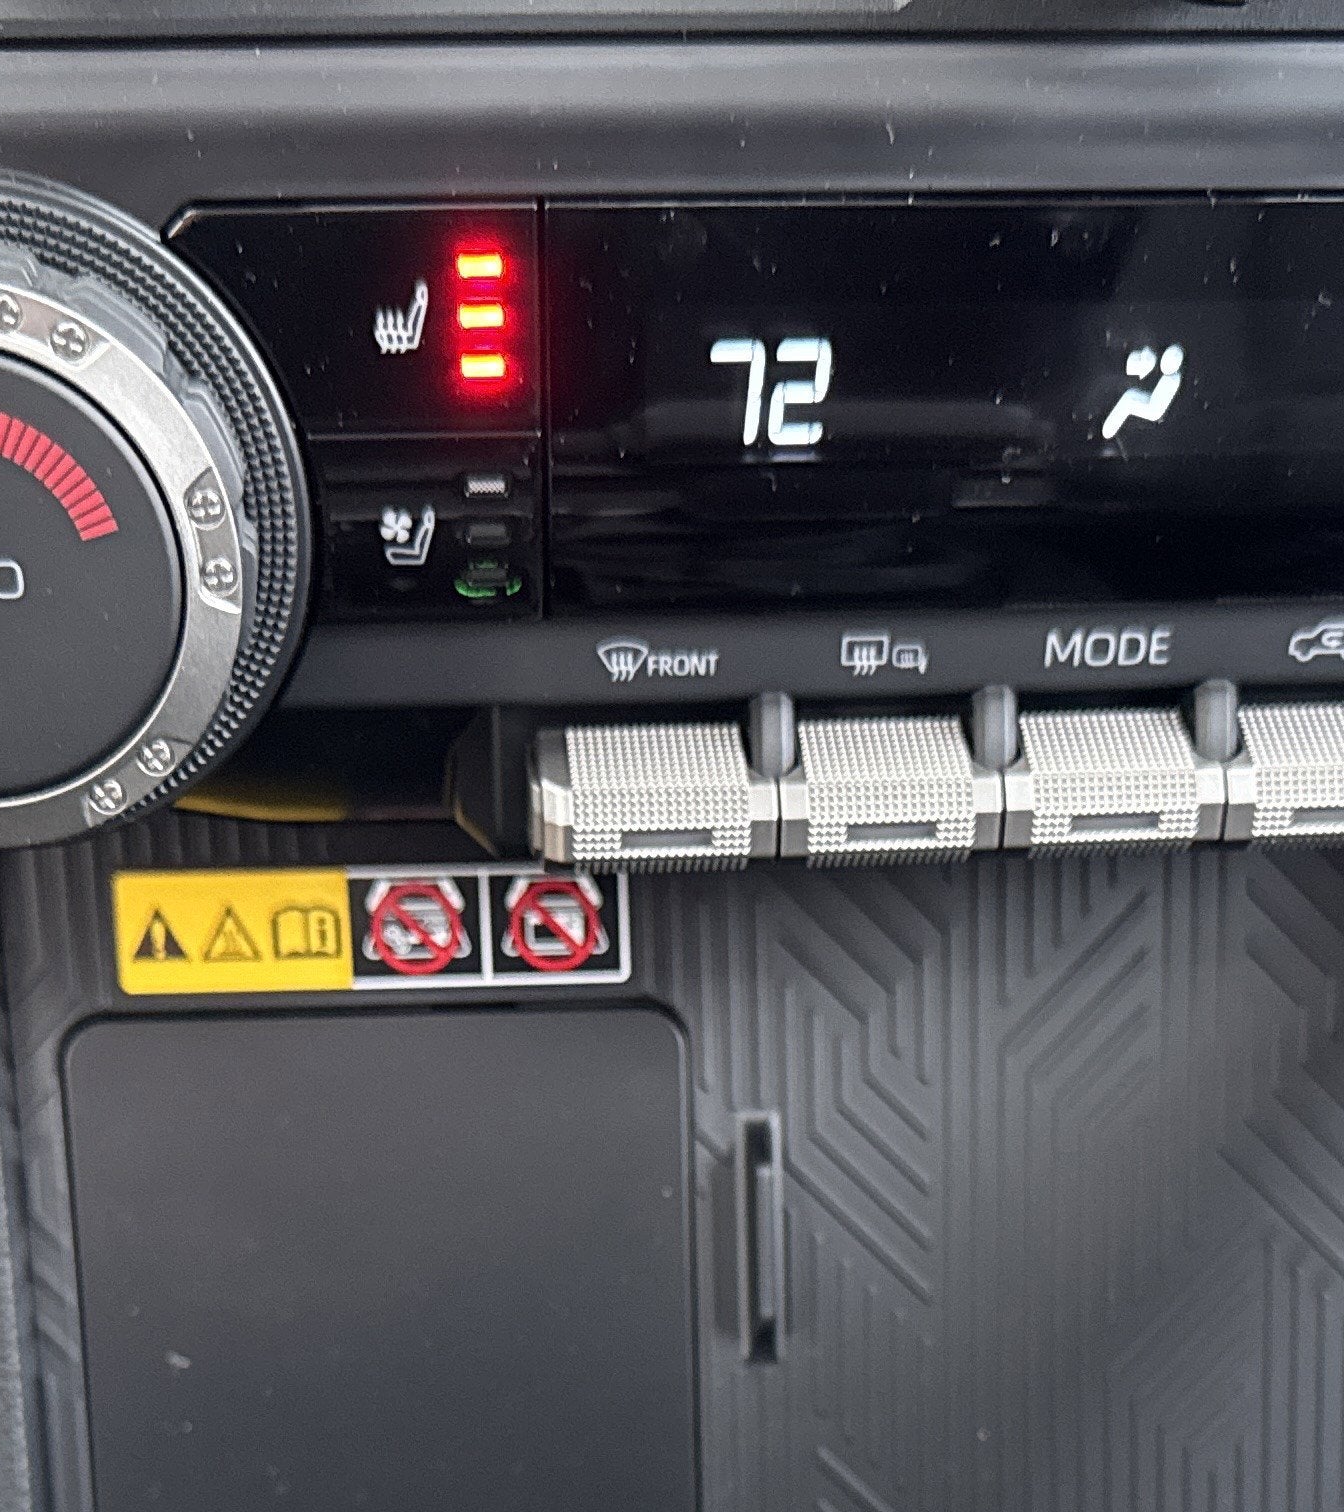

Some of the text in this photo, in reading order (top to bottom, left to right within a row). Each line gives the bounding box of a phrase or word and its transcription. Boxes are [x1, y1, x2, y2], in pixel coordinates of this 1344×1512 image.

[711, 337, 832, 446] 72
[646, 652, 720, 677] FRONT
[1044, 627, 1172, 667] MODE
